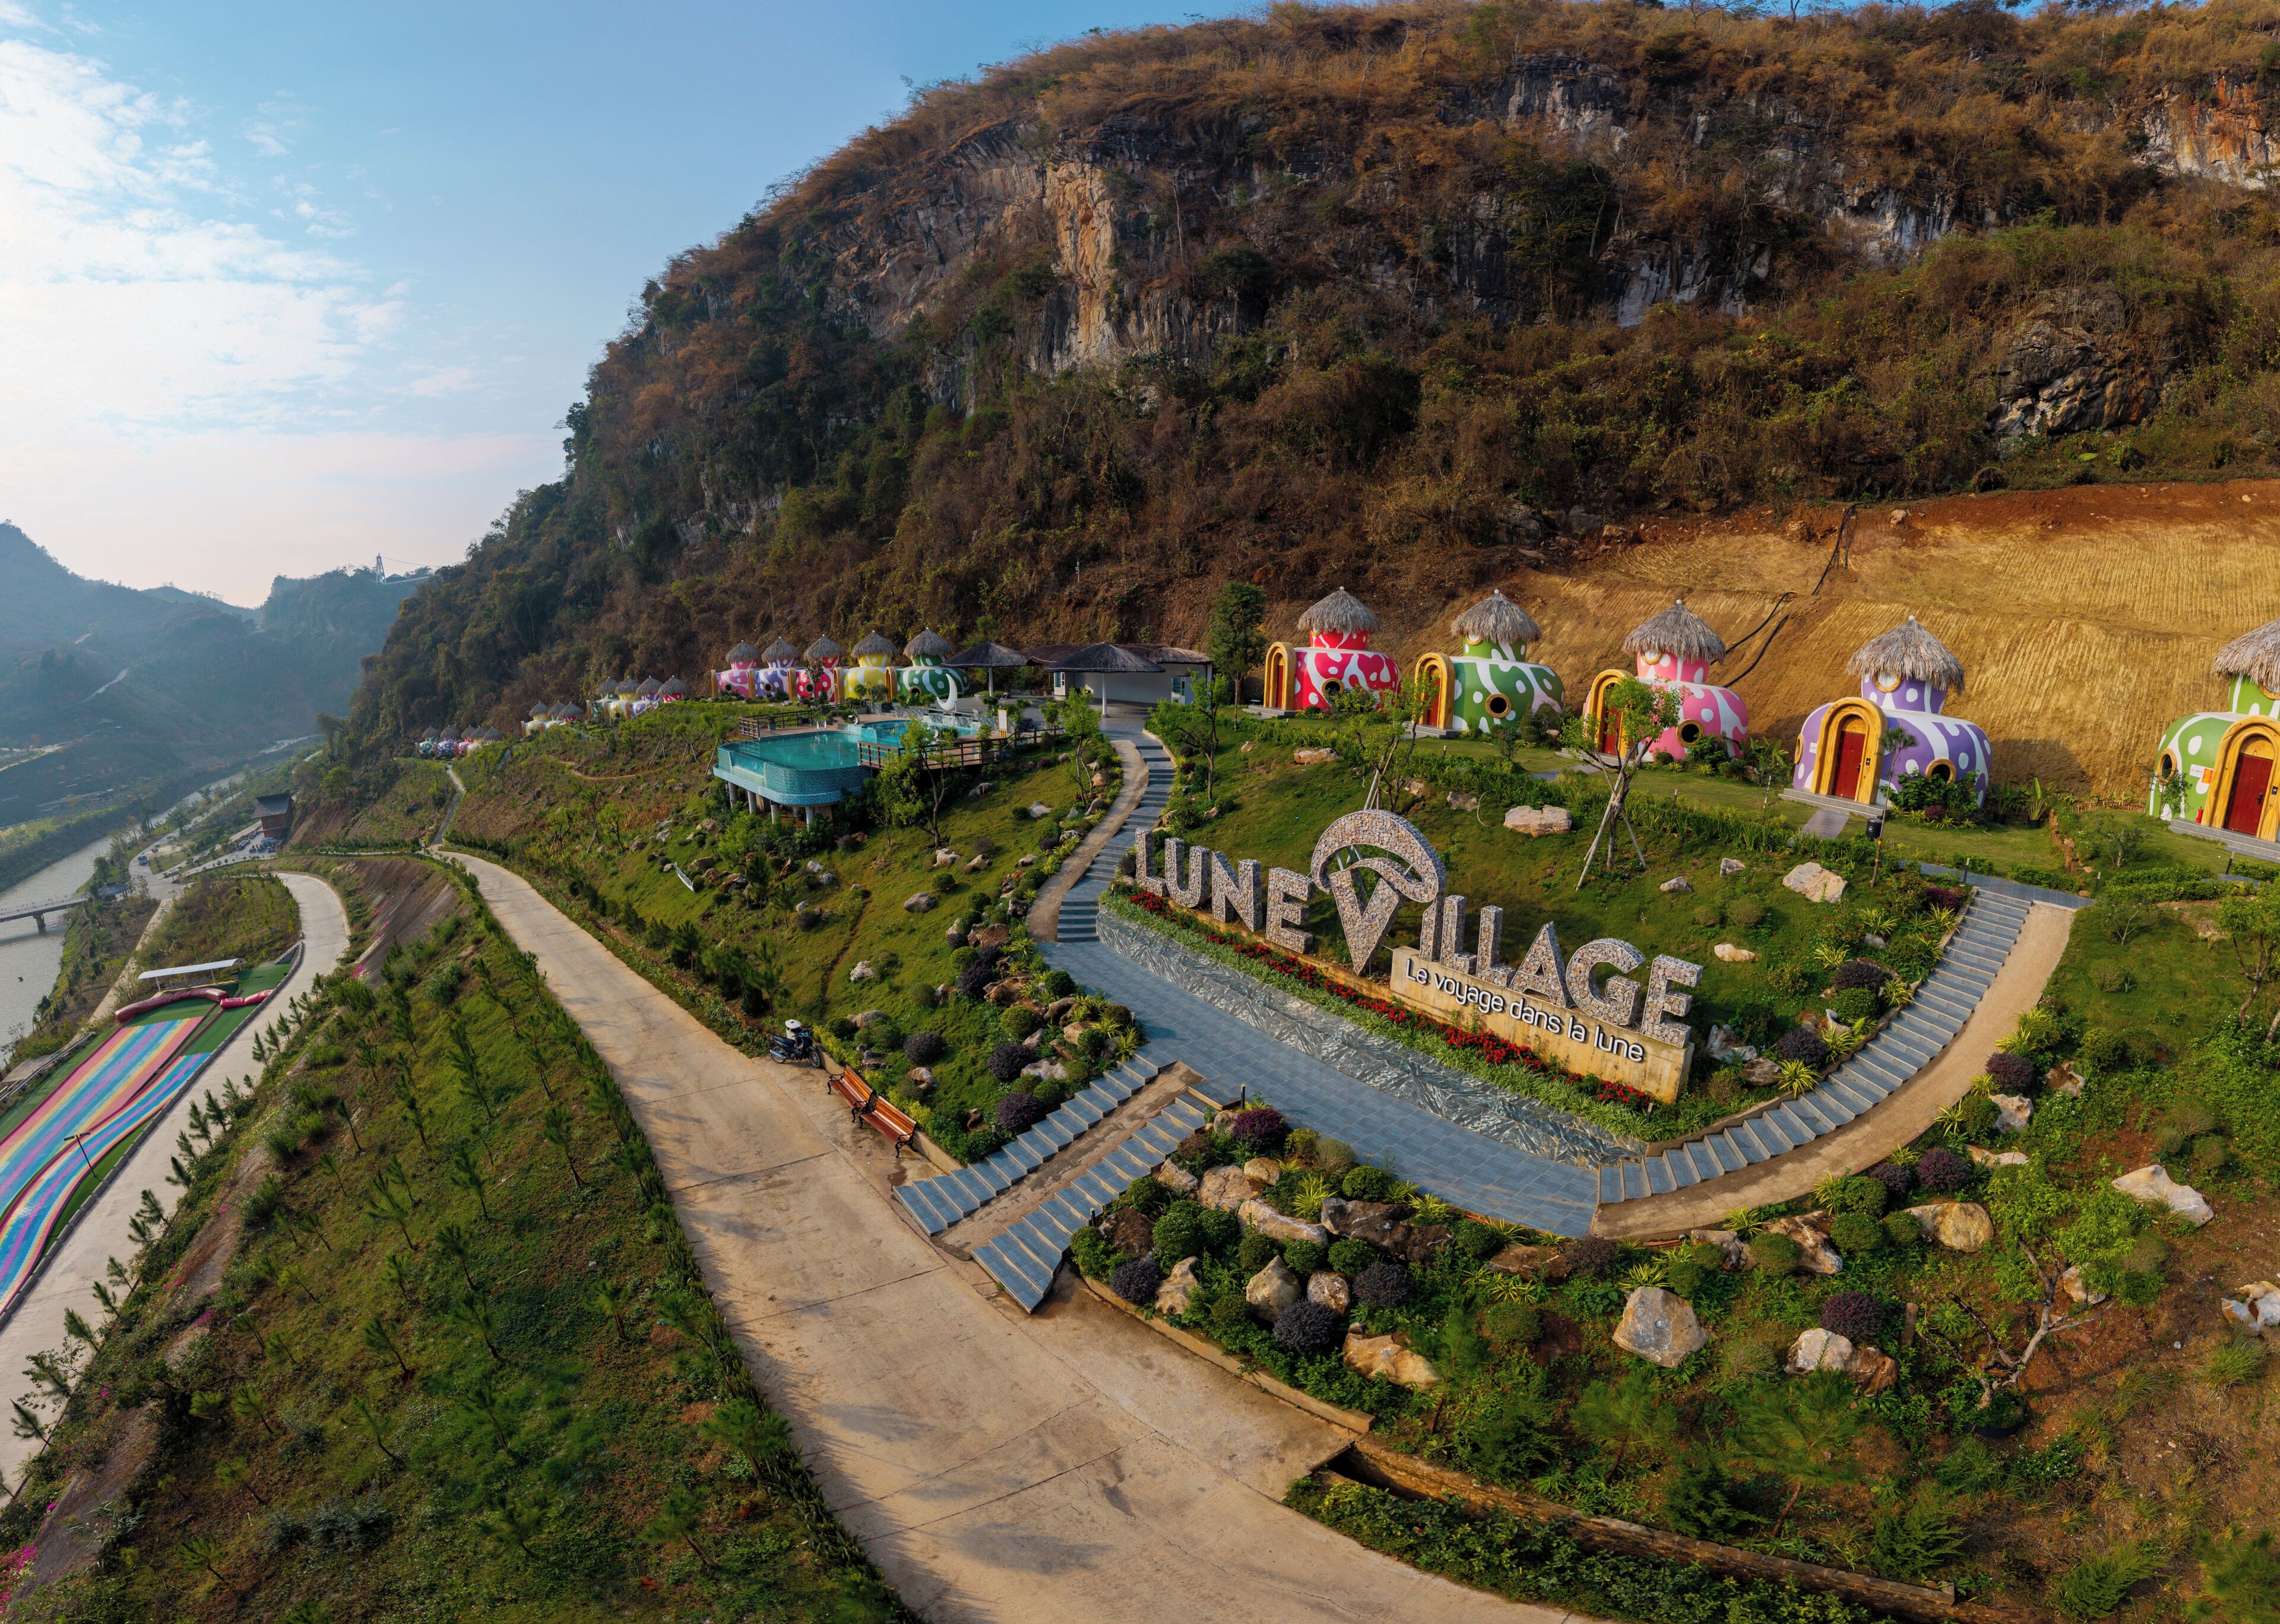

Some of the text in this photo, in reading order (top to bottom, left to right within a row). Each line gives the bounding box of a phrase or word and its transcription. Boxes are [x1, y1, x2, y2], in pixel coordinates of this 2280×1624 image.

[1135, 827, 1704, 1049] LUNE VILLAGE
[1405, 958, 1645, 1063] Le voyage dans la lune
